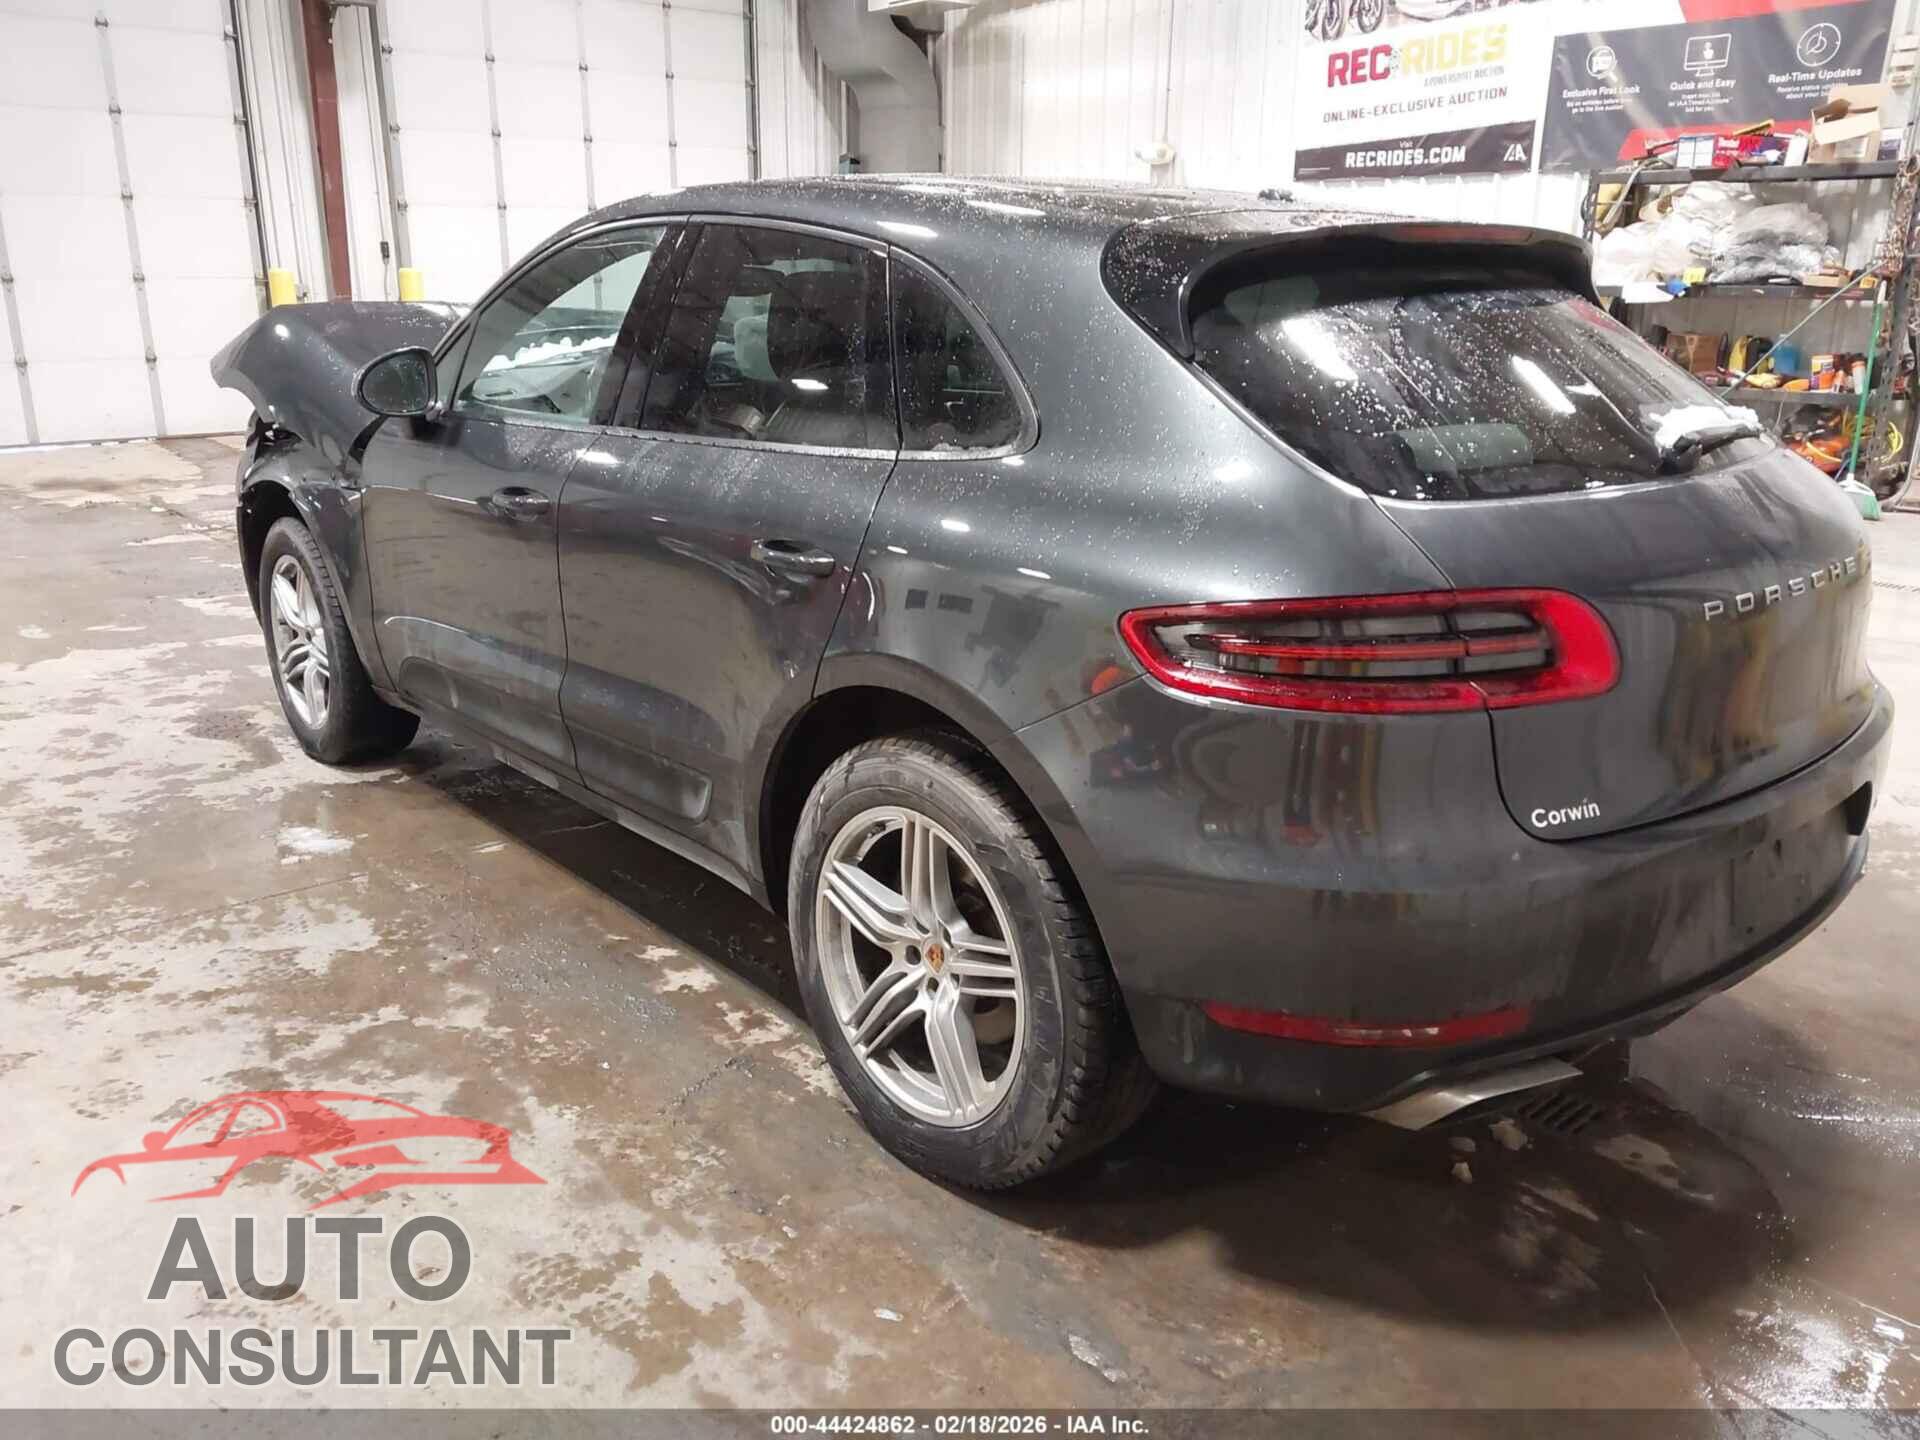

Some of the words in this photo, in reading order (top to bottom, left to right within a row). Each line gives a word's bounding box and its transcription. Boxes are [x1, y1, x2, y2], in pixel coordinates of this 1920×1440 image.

[1327, 44, 1391, 88] REC
[1400, 23, 1507, 76] RIDES
[1670, 81, 1696, 91] Quick
[1697, 80, 1713, 88] and
[1715, 78, 1737, 88] Easy
[1768, 71, 1816, 84] Real-Time
[1818, 68, 1863, 81] Updates
[1323, 97, 1444, 123] ONLINE-EXCLUSIVE
[1449, 86, 1508, 106] AUCTION
[1562, 88, 1598, 98] Exclusive
[1599, 86, 1617, 95] First
[1619, 85, 1641, 94] Look
[1345, 145, 1466, 168] RECRIDES.COM
[1704, 556, 1857, 621] PORSCHE
[1531, 798, 1600, 828] Corwin
